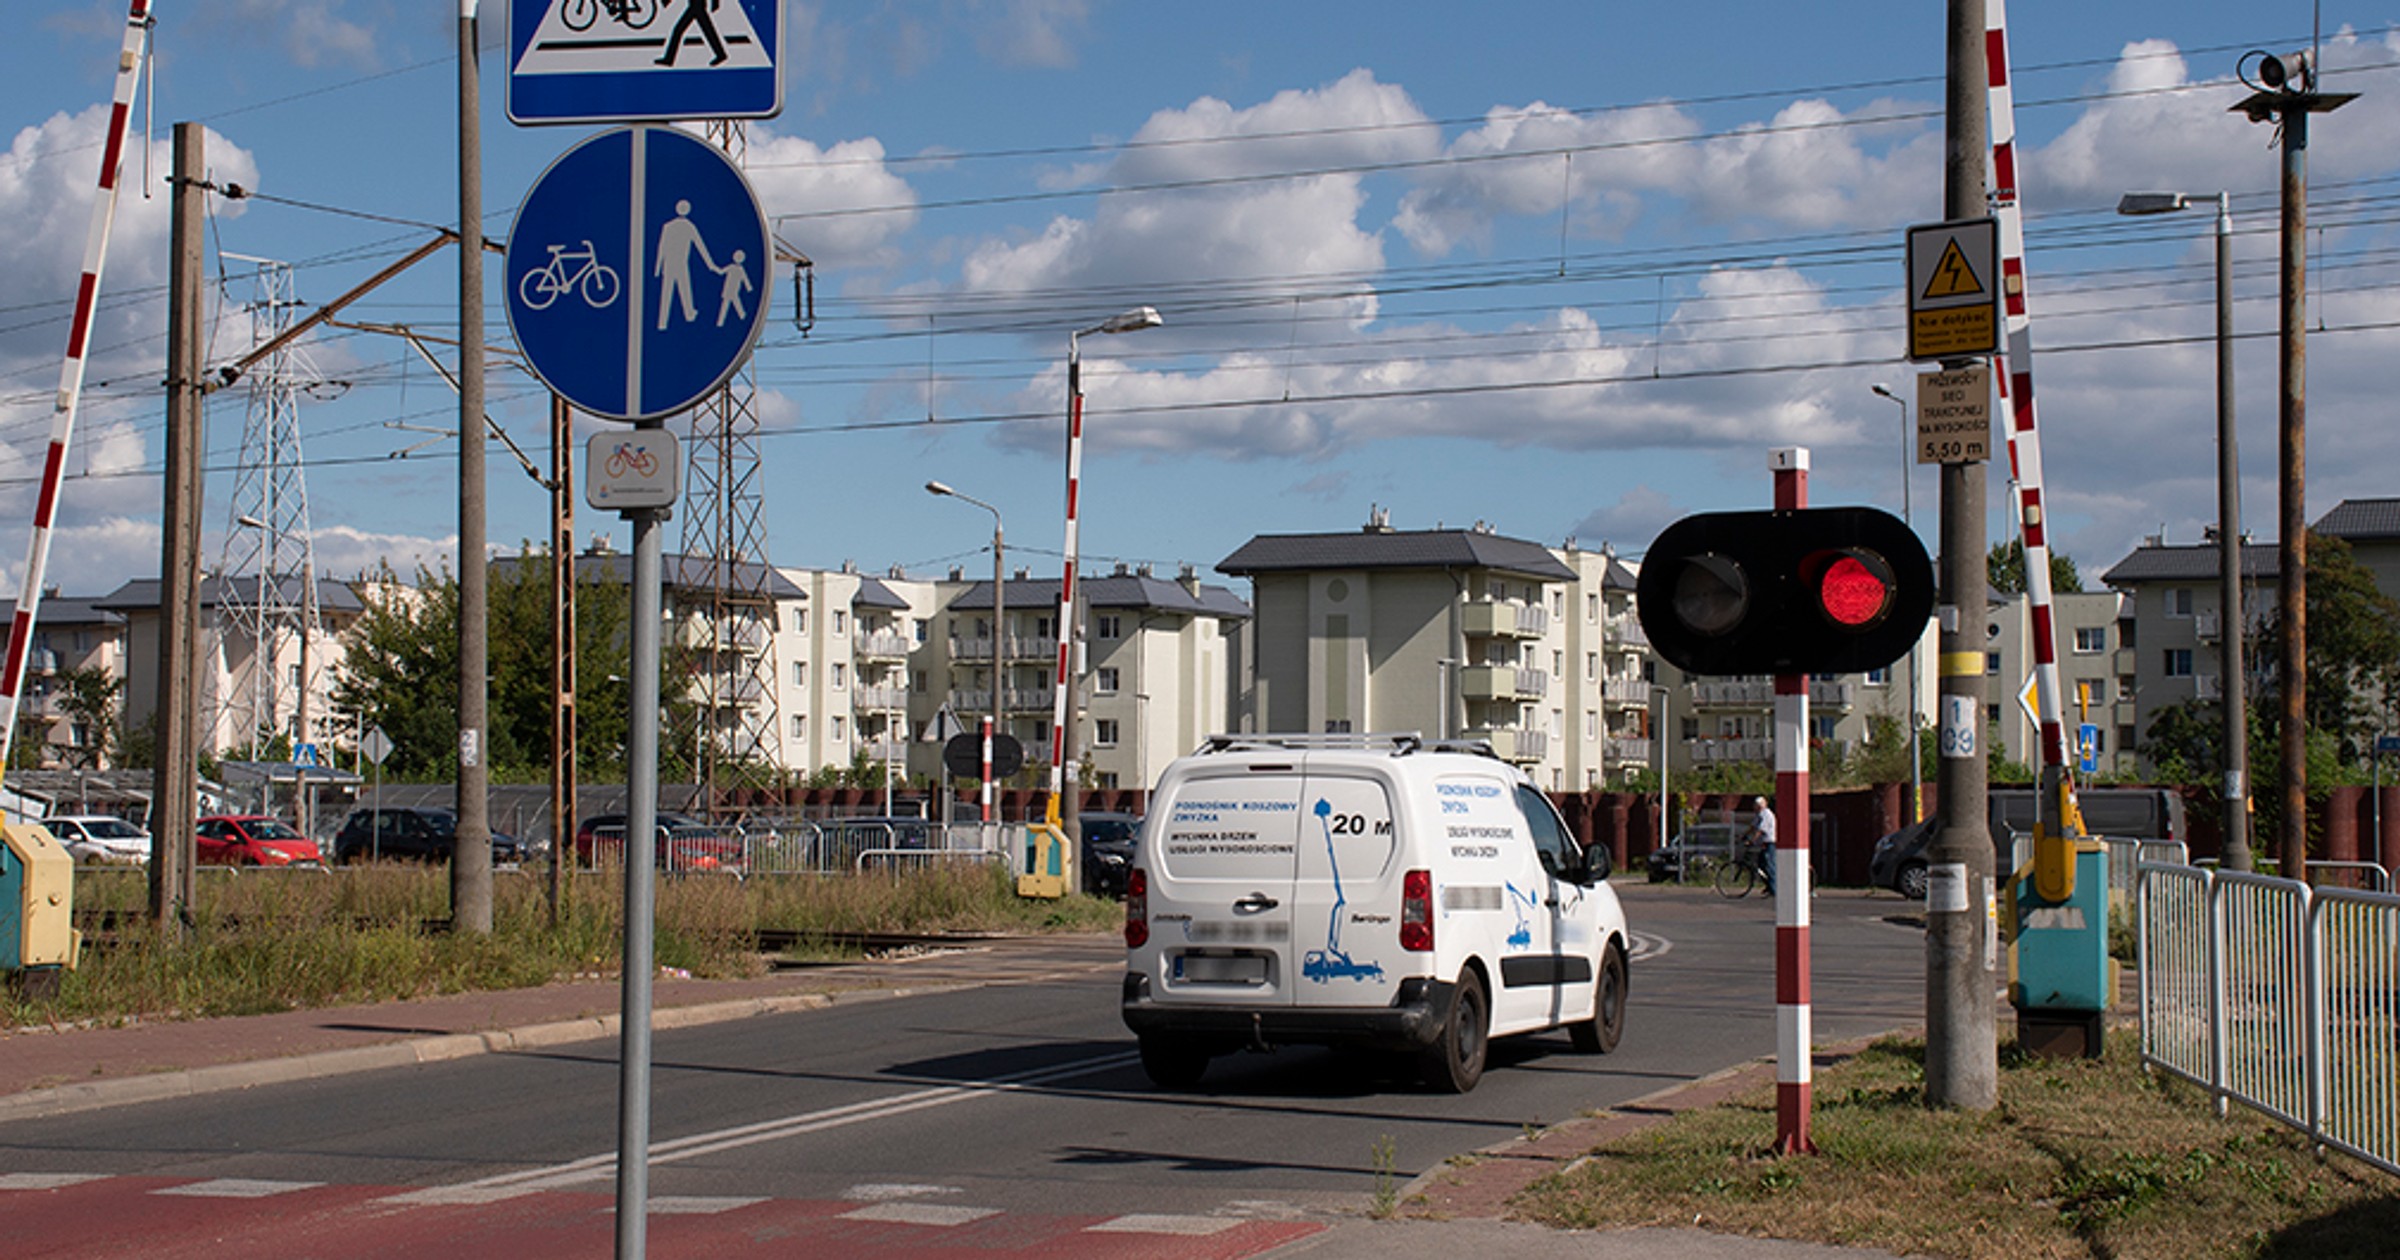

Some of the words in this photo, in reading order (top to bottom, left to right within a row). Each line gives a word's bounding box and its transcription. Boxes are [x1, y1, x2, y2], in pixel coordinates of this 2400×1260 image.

[1918, 317, 1938, 327] Nie
[1941, 389, 1966, 403] SIECI
[1924, 405, 1984, 419] TRAKCYJNEJ
[1918, 424, 1932, 434] NA
[1966, 441, 1983, 455] m
[1779, 451, 1785, 466] 1
[1952, 700, 1960, 724] 1
[1242, 801, 1297, 811] KOSZOWY
[1332, 814, 1365, 836] 20
[1171, 832, 1218, 841] WYCINKA
[1351, 913, 1391, 925] Berlingo
